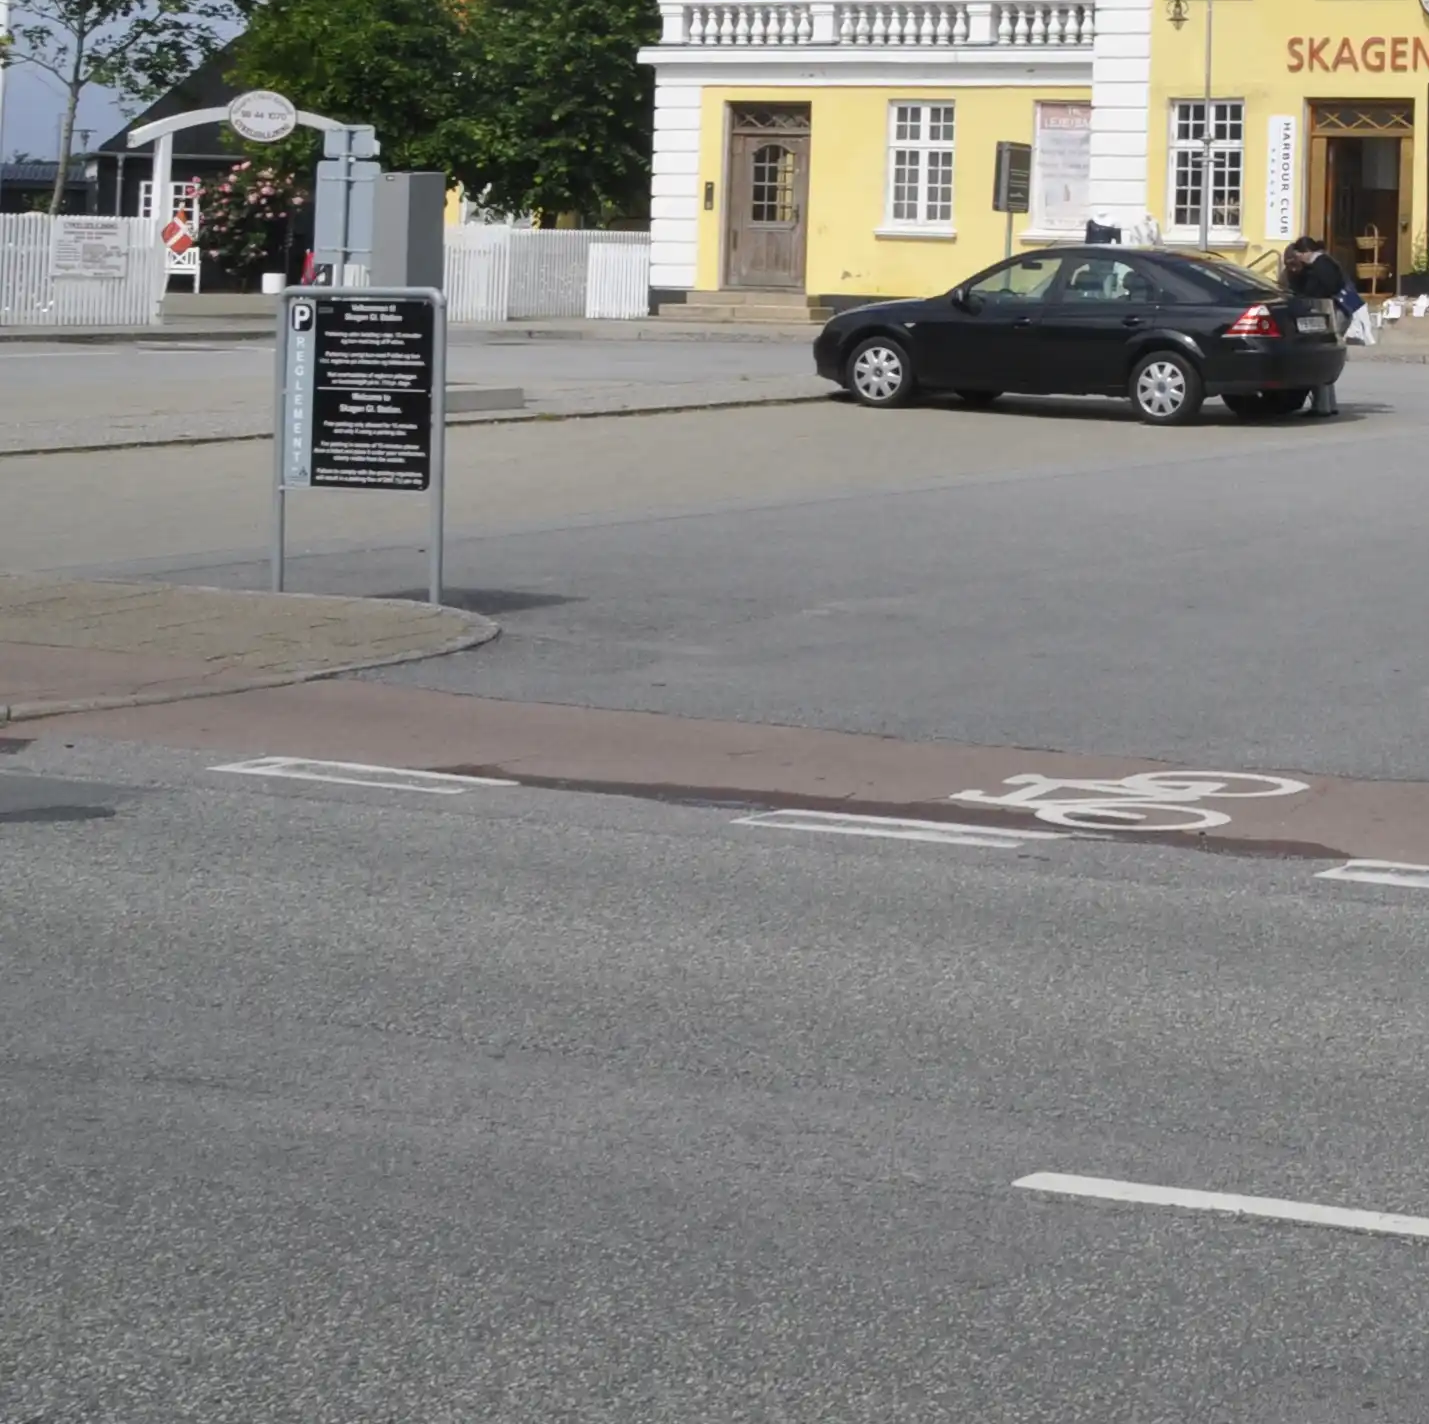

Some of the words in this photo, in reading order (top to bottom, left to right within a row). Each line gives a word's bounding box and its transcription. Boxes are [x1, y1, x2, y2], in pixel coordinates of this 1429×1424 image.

[1280, 122, 1292, 192] HARBOUR
[1279, 198, 1290, 234] CLUB
[294, 306, 310, 330] P
[292, 336, 306, 462] REGLEMENT
